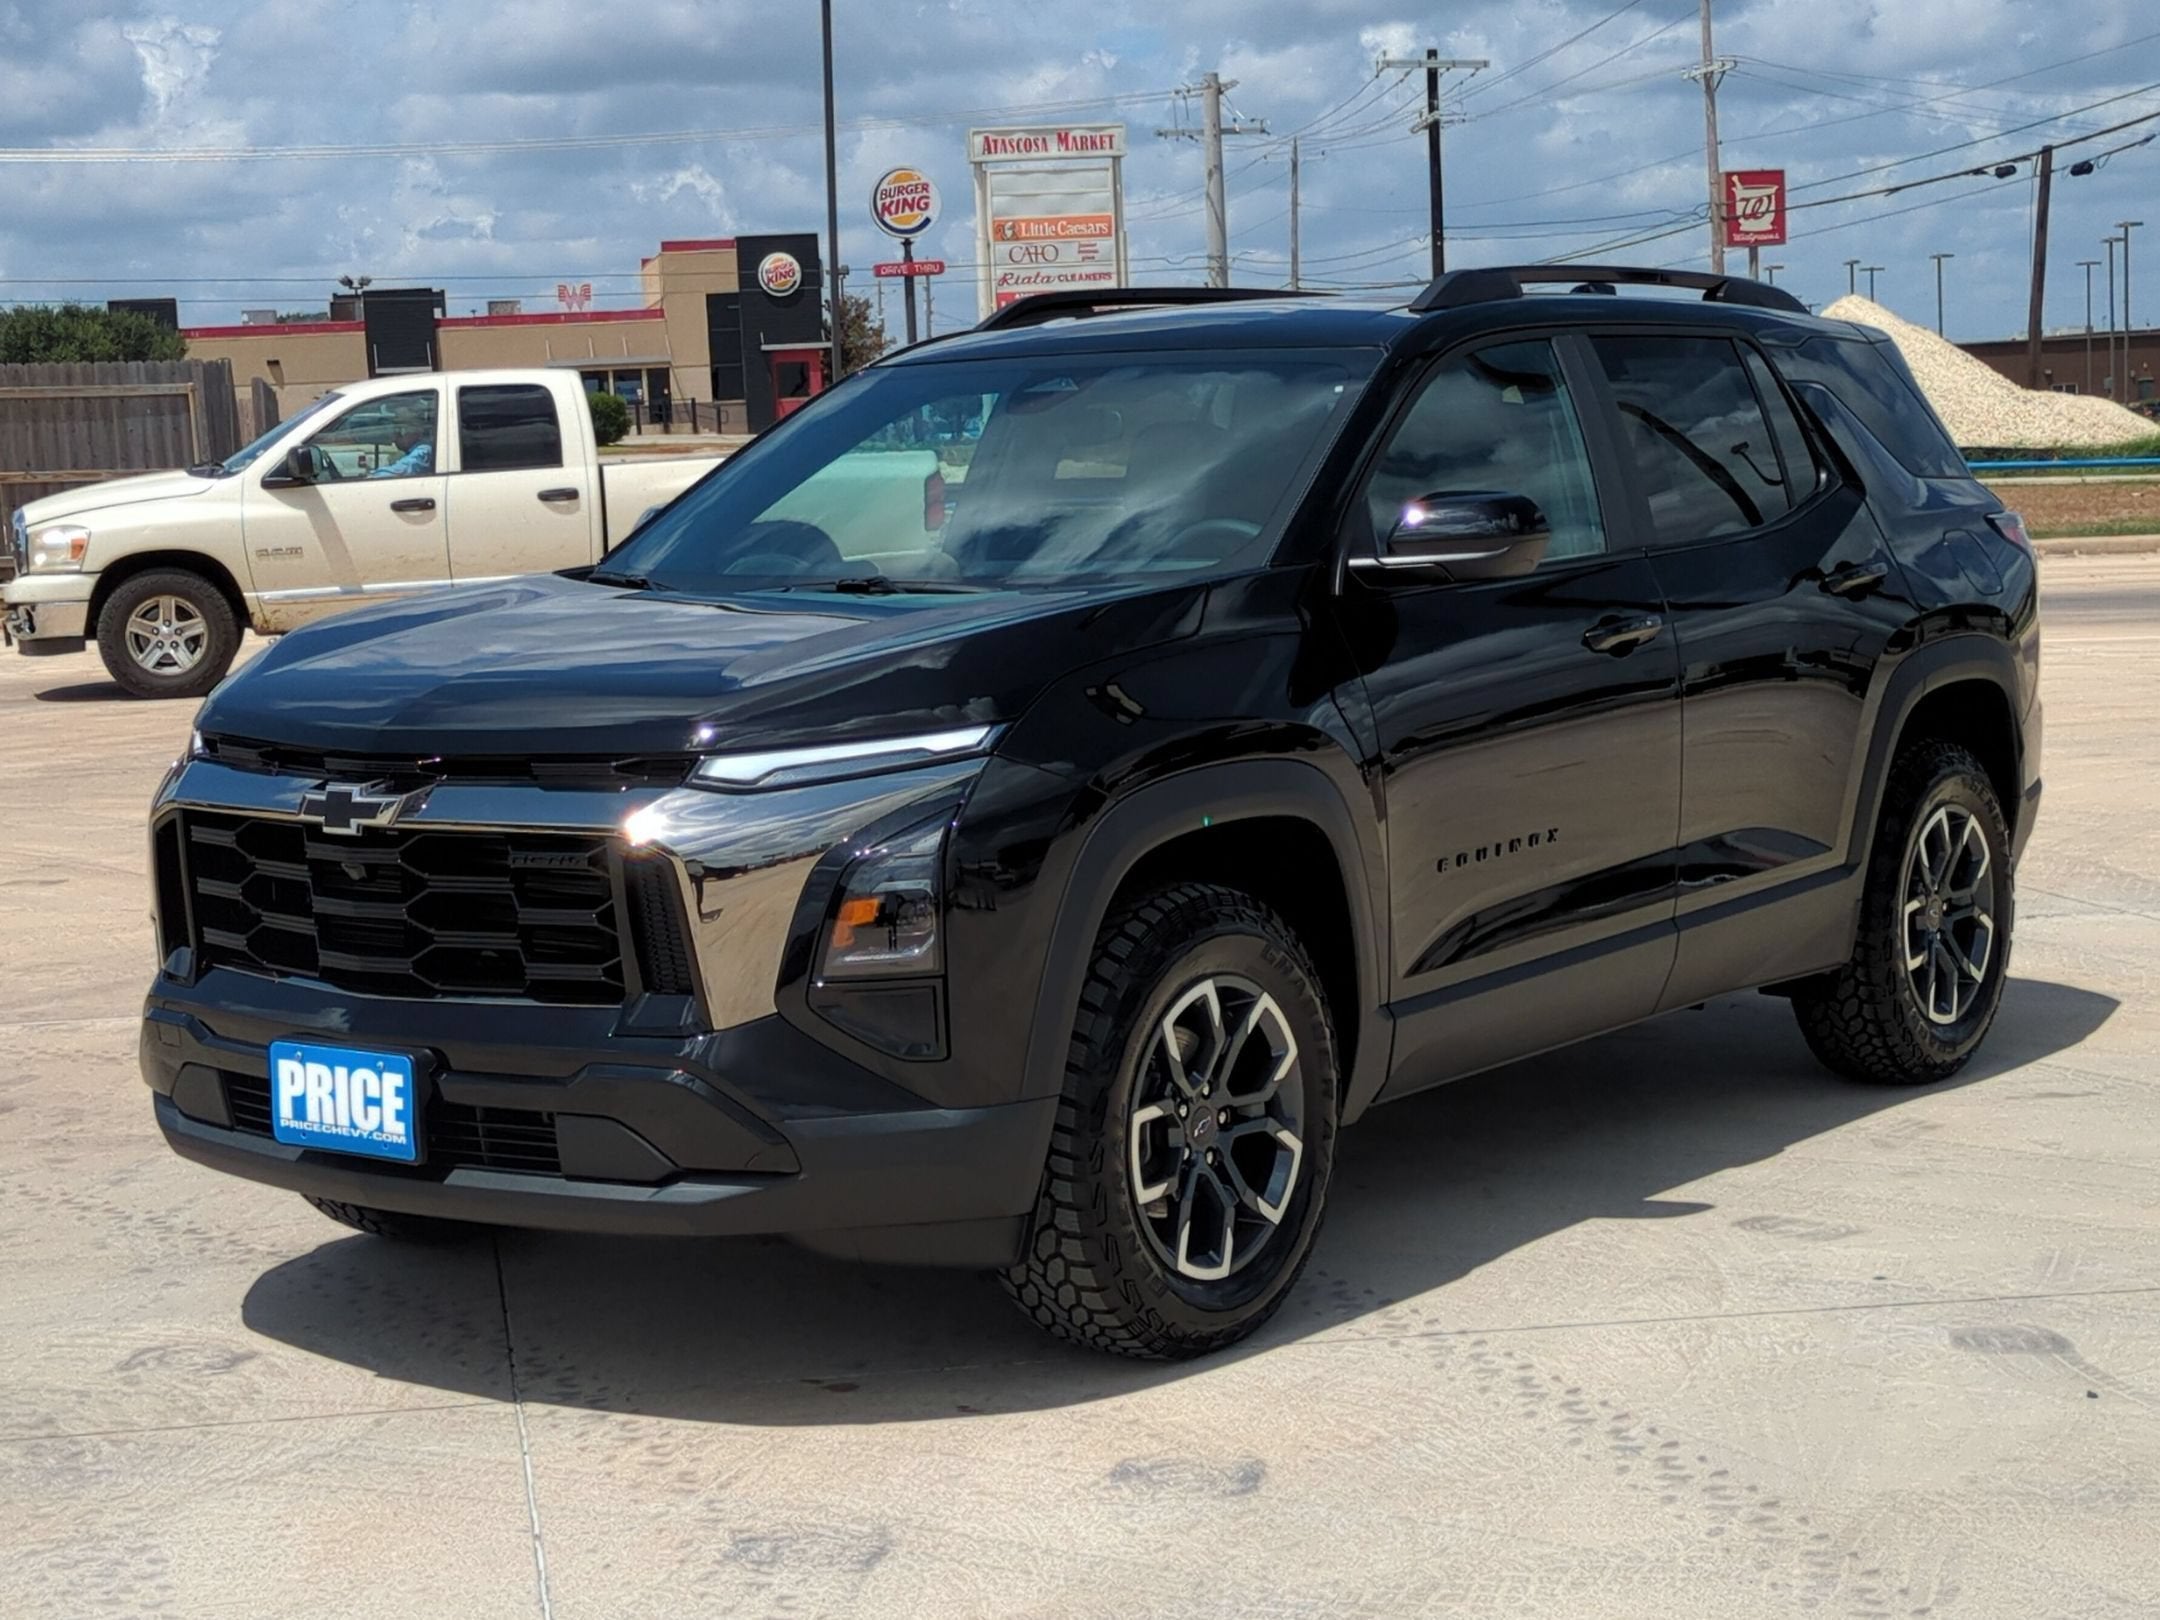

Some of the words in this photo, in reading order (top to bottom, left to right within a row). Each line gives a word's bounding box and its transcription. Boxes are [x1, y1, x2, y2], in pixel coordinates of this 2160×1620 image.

[982, 135, 1049, 155] ATASCOSA
[1057, 131, 1115, 152] MARKET
[880, 182, 930, 200] BURGER
[879, 195, 930, 218] KING
[1020, 221, 1056, 238] Little
[1057, 220, 1109, 236] Caesars
[1008, 243, 1059, 263] CATO
[766, 268, 796, 287] KING
[880, 264, 908, 276] DRIVE
[914, 262, 940, 274] THRU
[1057, 271, 1112, 283] CLEANERS
[1436, 828, 1560, 873] EQUINOX
[277, 1058, 406, 1135] PRICE
[280, 1118, 407, 1144] PRICECHEVY.COM
